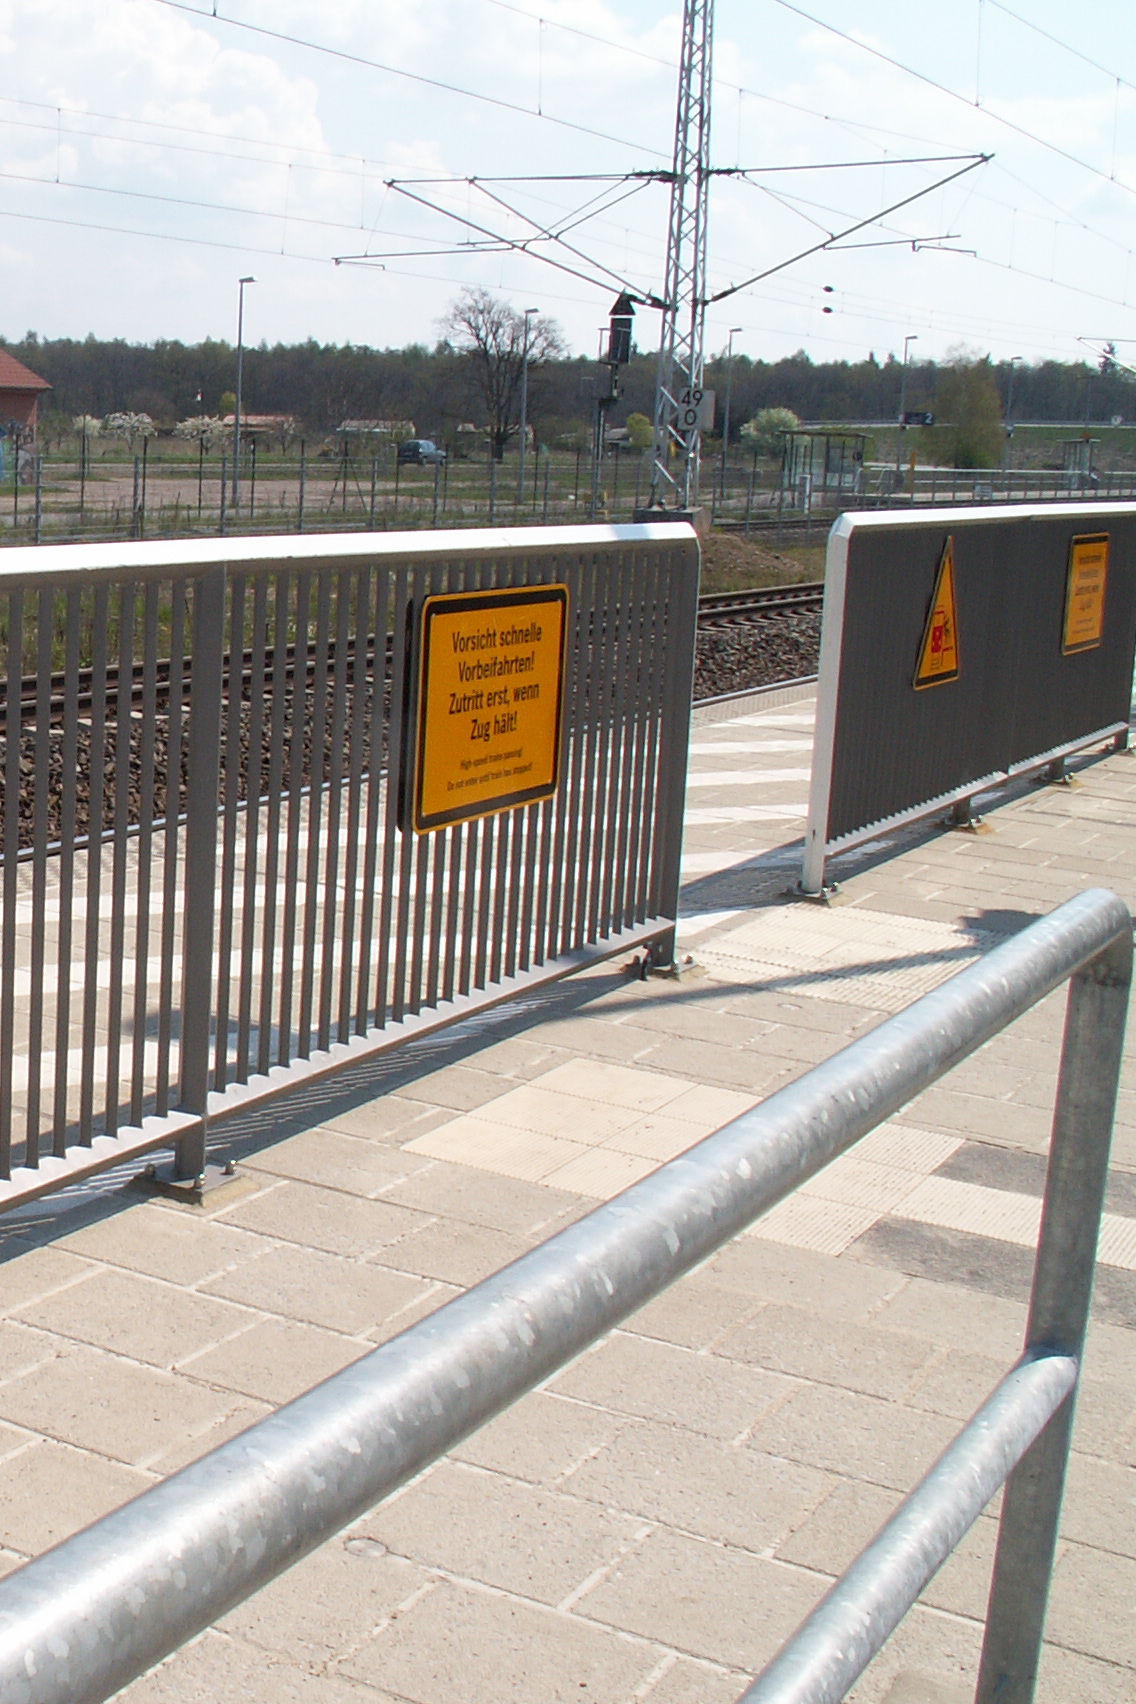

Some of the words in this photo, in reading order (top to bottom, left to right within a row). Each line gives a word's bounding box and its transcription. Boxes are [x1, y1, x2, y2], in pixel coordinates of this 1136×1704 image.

[681, 390, 703, 407] 49
[684, 409, 697, 426] 0
[925, 413, 933, 424] 2
[452, 628, 497, 653] Vorsicht
[500, 622, 542, 647] schnelle
[458, 650, 535, 683] Vorbeifahrten!
[449, 689, 484, 715] Zutritt
[486, 685, 510, 708] erst,
[513, 683, 540, 702] wenn
[470, 719, 491, 742] Zug
[493, 710, 518, 735] hält!
